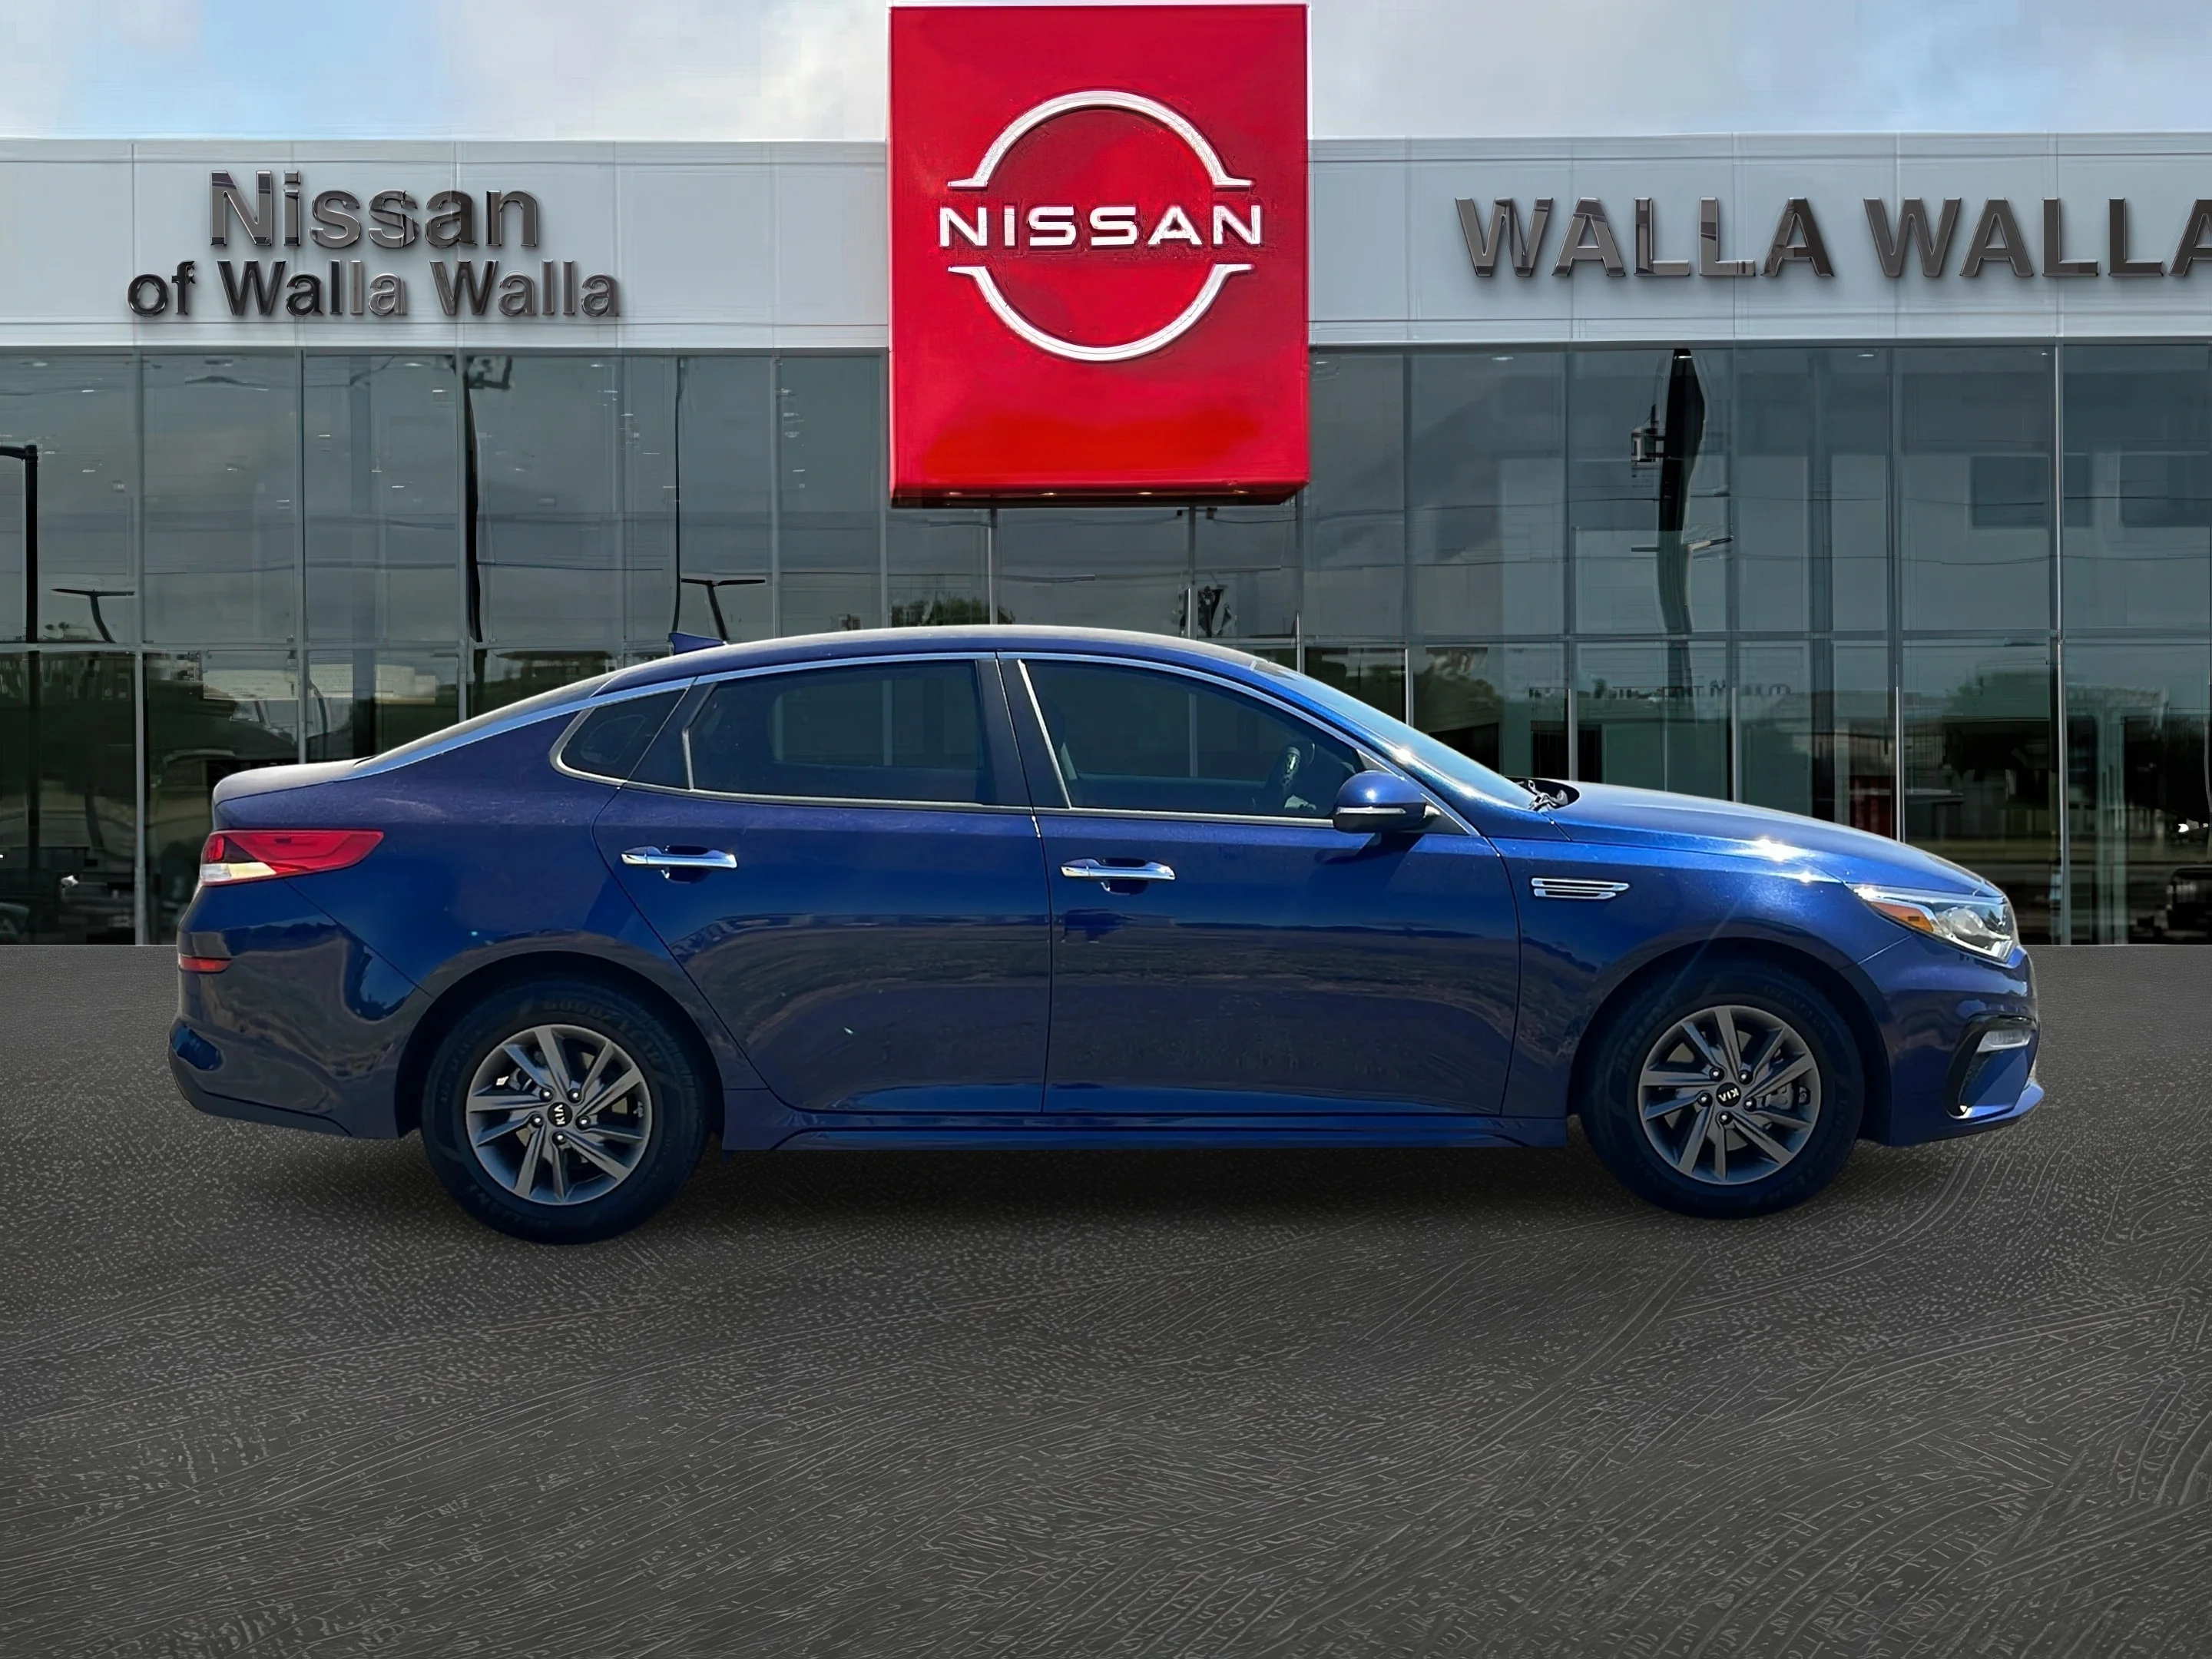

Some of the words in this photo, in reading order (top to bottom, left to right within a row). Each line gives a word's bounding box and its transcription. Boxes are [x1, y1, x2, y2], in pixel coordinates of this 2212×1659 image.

[210, 170, 541, 248] Nissan
[939, 204, 1262, 248] NISSAN
[1455, 197, 1835, 277] WALLA
[127, 260, 196, 317] of
[216, 259, 409, 317] Walla
[428, 259, 620, 317] Walla
[554, 1104, 566, 1125] KIA
[1718, 1088, 1740, 1102] KIA
